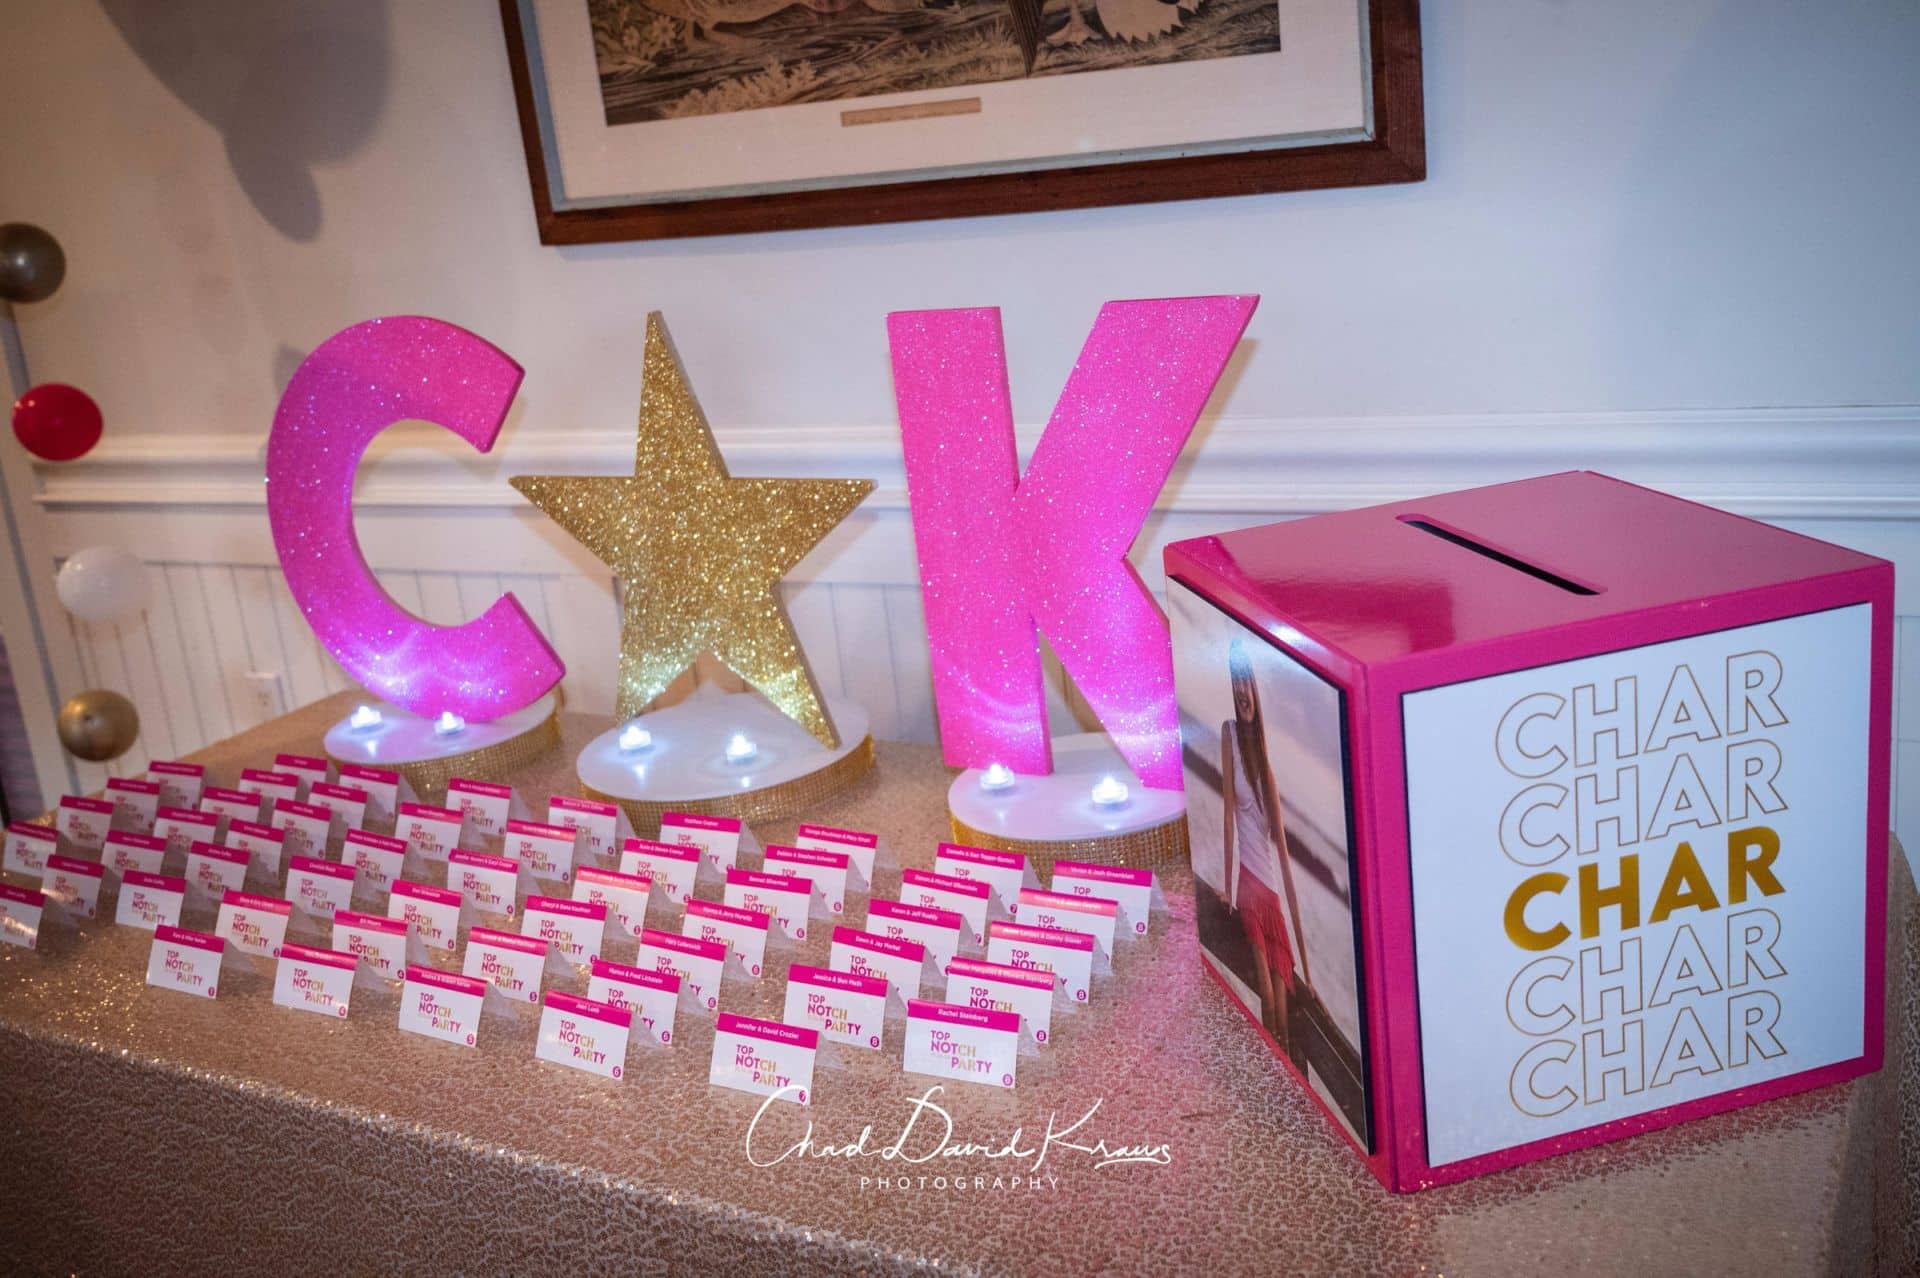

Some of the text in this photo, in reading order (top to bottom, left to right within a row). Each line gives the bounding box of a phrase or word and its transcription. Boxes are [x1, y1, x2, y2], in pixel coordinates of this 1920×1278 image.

[266, 294, 1260, 791] C K
[1495, 649, 1788, 779] CHAR
[1498, 739, 1788, 867] CHAR
[520, 850, 547, 861] NOTCH
[782, 869, 796, 877] TOP
[955, 868, 970, 877] TOP
[463, 880, 491, 892] NOTCH
[1073, 886, 1091, 895] TOP
[1503, 826, 1786, 951] CHAR
[476, 893, 500, 904] PARTY
[590, 890, 603, 898] TOP
[920, 895, 935, 904] TOP
[234, 913, 246, 921] TOP
[404, 913, 432, 924] NOTCH
[1038, 915, 1055, 924] TOP
[232, 922, 259, 933] NOTCH
[541, 920, 555, 928] TOP
[702, 925, 716, 934] TOP
[540, 929, 572, 941] NOTCH
[888, 926, 903, 935] TOP
[349, 944, 379, 956] NOTCH
[1011, 949, 1029, 959] TOP
[483, 953, 497, 961] TOP
[657, 956, 672, 965] TOP
[851, 955, 866, 964] TOP
[165, 960, 193, 972] NOTCH
[482, 963, 513, 976] NOTCH
[294, 968, 308, 976] TOP
[1506, 908, 1788, 1037] CHAR
[177, 972, 202, 985] PARTY
[495, 976, 523, 990] PARTY
[293, 979, 324, 992] NOTCH
[420, 993, 434, 1001] TOP
[608, 989, 623, 997] TOP
[970, 987, 989, 997] TOP
[305, 992, 333, 1005] PARTY
[808, 994, 825, 1004] TOP
[419, 1003, 452, 1017] NOTCH
[970, 997, 1012, 1013] NOTCH
[808, 1004, 848, 1020] NOTCH
[938, 1009, 958, 1017] Rachel
[432, 1017, 461, 1032] PARTY
[561, 1020, 576, 1029] TOP
[825, 1019, 861, 1035] PARTY
[559, 1030, 595, 1048] NOTCH
[931, 1030, 950, 1040] TOP
[736, 1044, 754, 1054] TOP
[931, 1041, 976, 1057] NOTCH
[1509, 991, 1787, 1118] CHAR
[573, 1047, 606, 1064] PARTY
[736, 1055, 776, 1072] NOTCH
[951, 1057, 992, 1073] PARTY
[753, 1072, 790, 1087] PARTY
